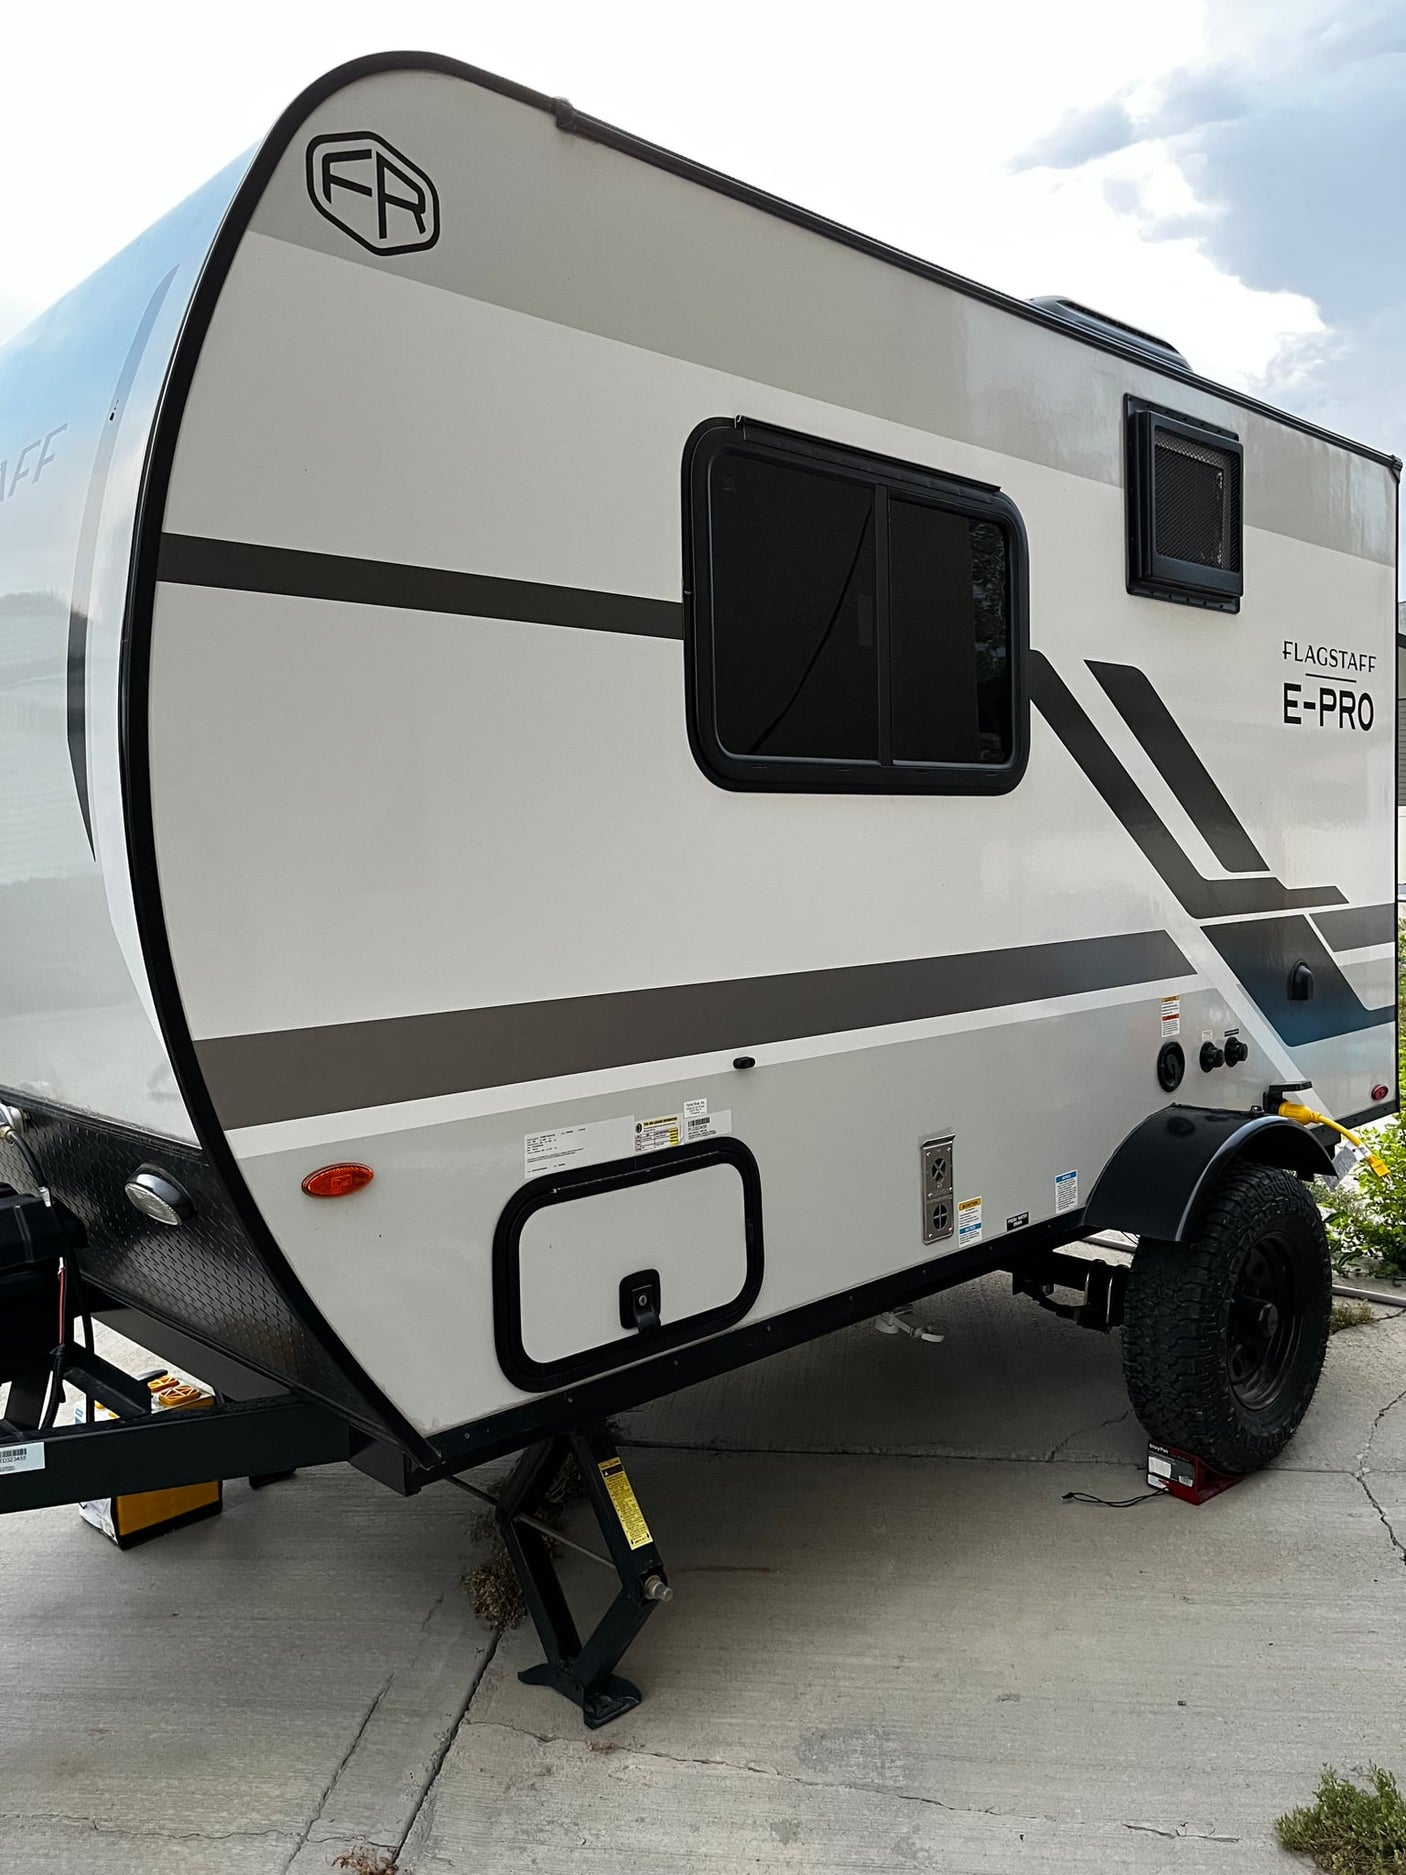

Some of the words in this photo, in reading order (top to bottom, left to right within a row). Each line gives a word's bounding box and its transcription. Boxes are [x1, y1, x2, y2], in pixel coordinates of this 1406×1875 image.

[321, 148, 427, 240] FR
[1282, 640, 1377, 673] FLAGSTAFF
[1283, 682, 1375, 732] E-PRO
